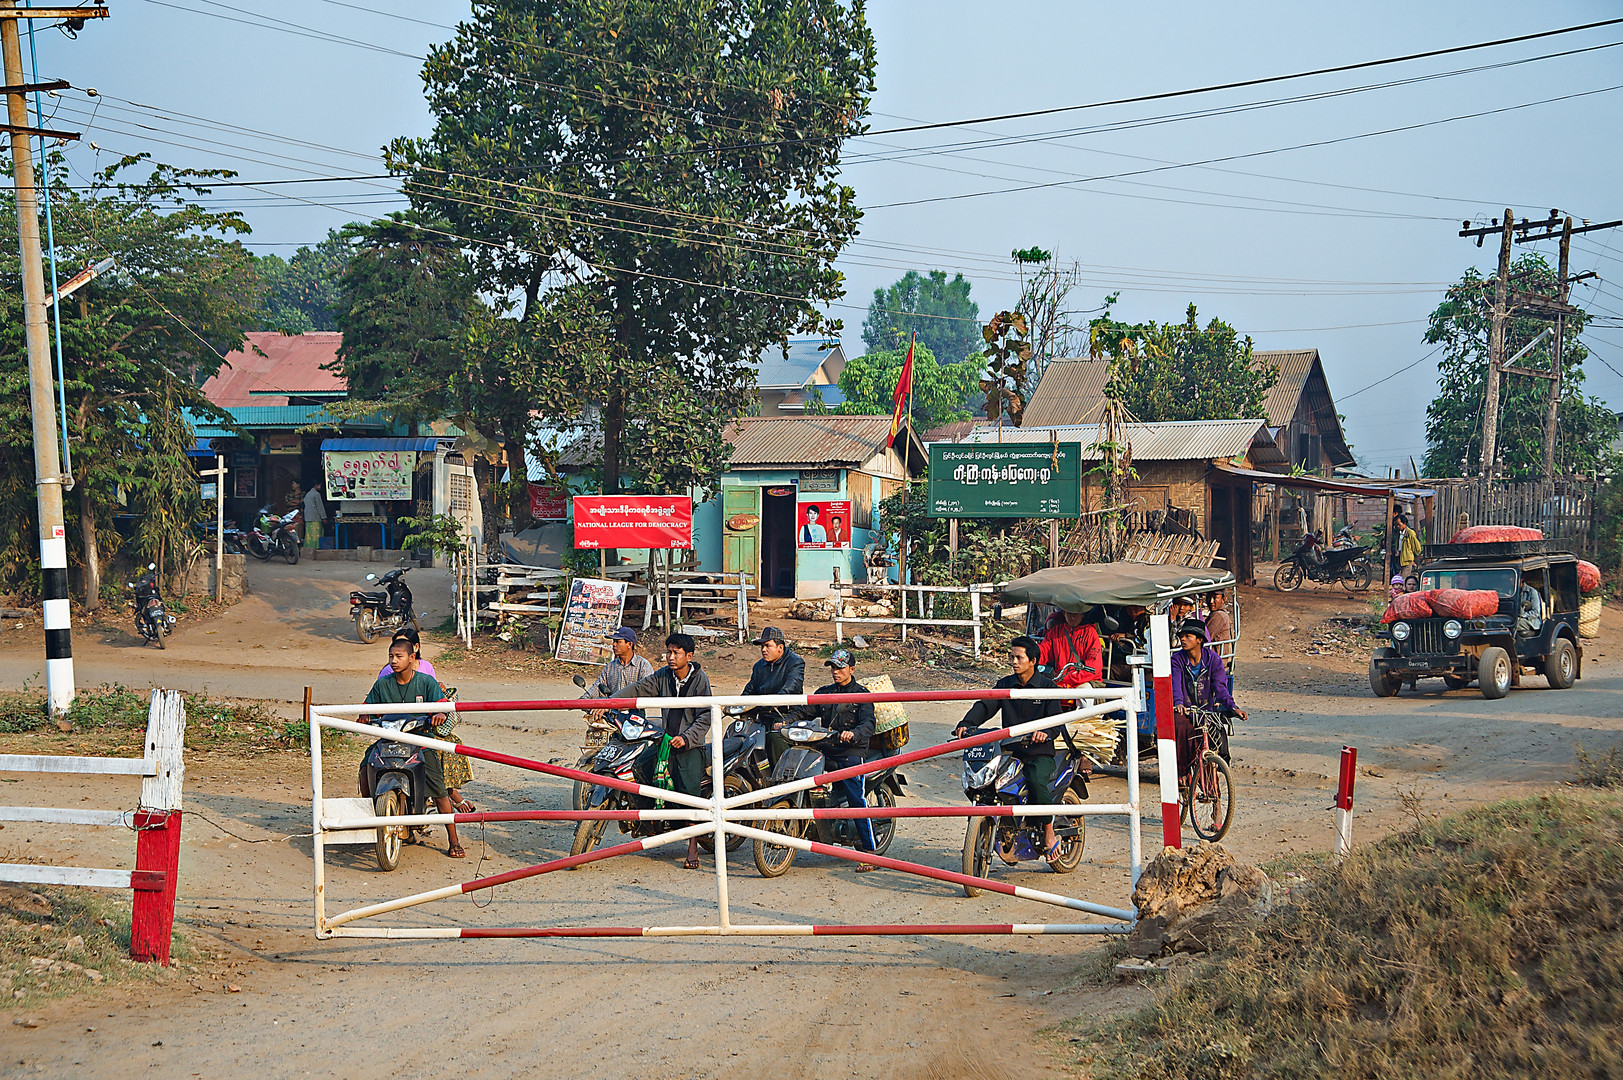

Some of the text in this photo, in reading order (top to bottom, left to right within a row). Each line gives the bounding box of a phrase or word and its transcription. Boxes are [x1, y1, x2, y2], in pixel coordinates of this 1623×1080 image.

[589, 504, 675, 517] အမျိုးသားဒီမိုကရေစီအဖွဲ့ချုပ်
